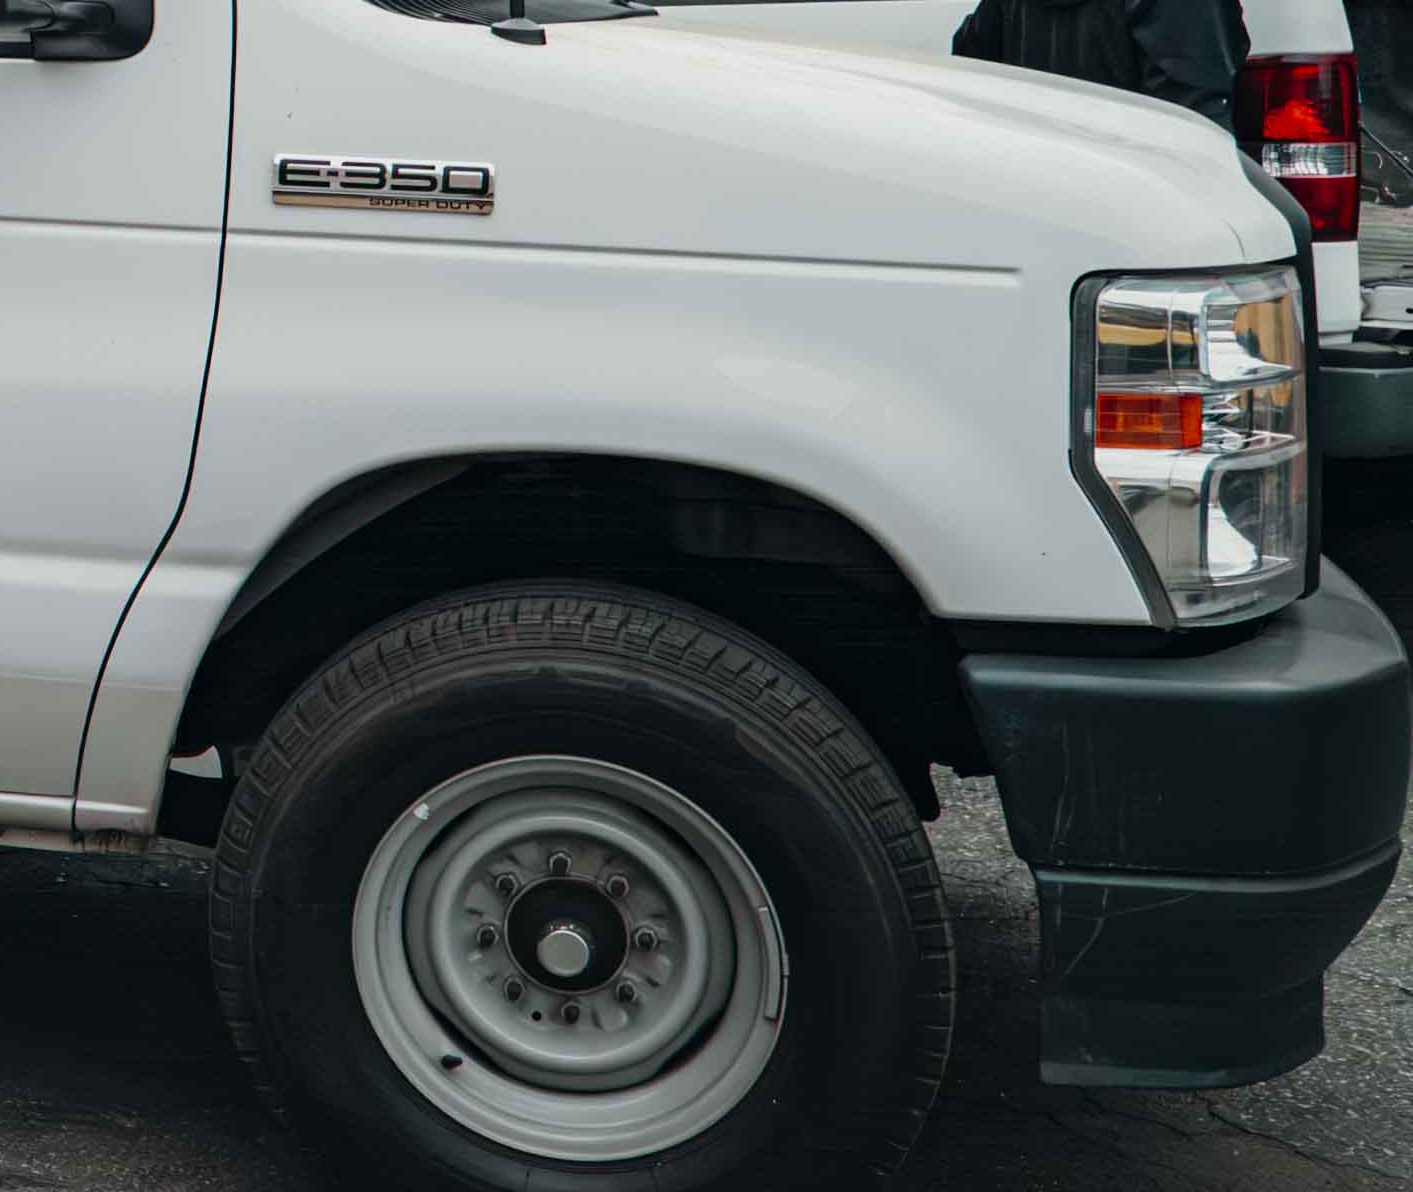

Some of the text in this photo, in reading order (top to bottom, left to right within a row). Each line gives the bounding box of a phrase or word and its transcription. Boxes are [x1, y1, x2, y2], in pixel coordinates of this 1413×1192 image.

[278, 158, 490, 195] E-350
[369, 198, 486, 210] SUPER DUTY
